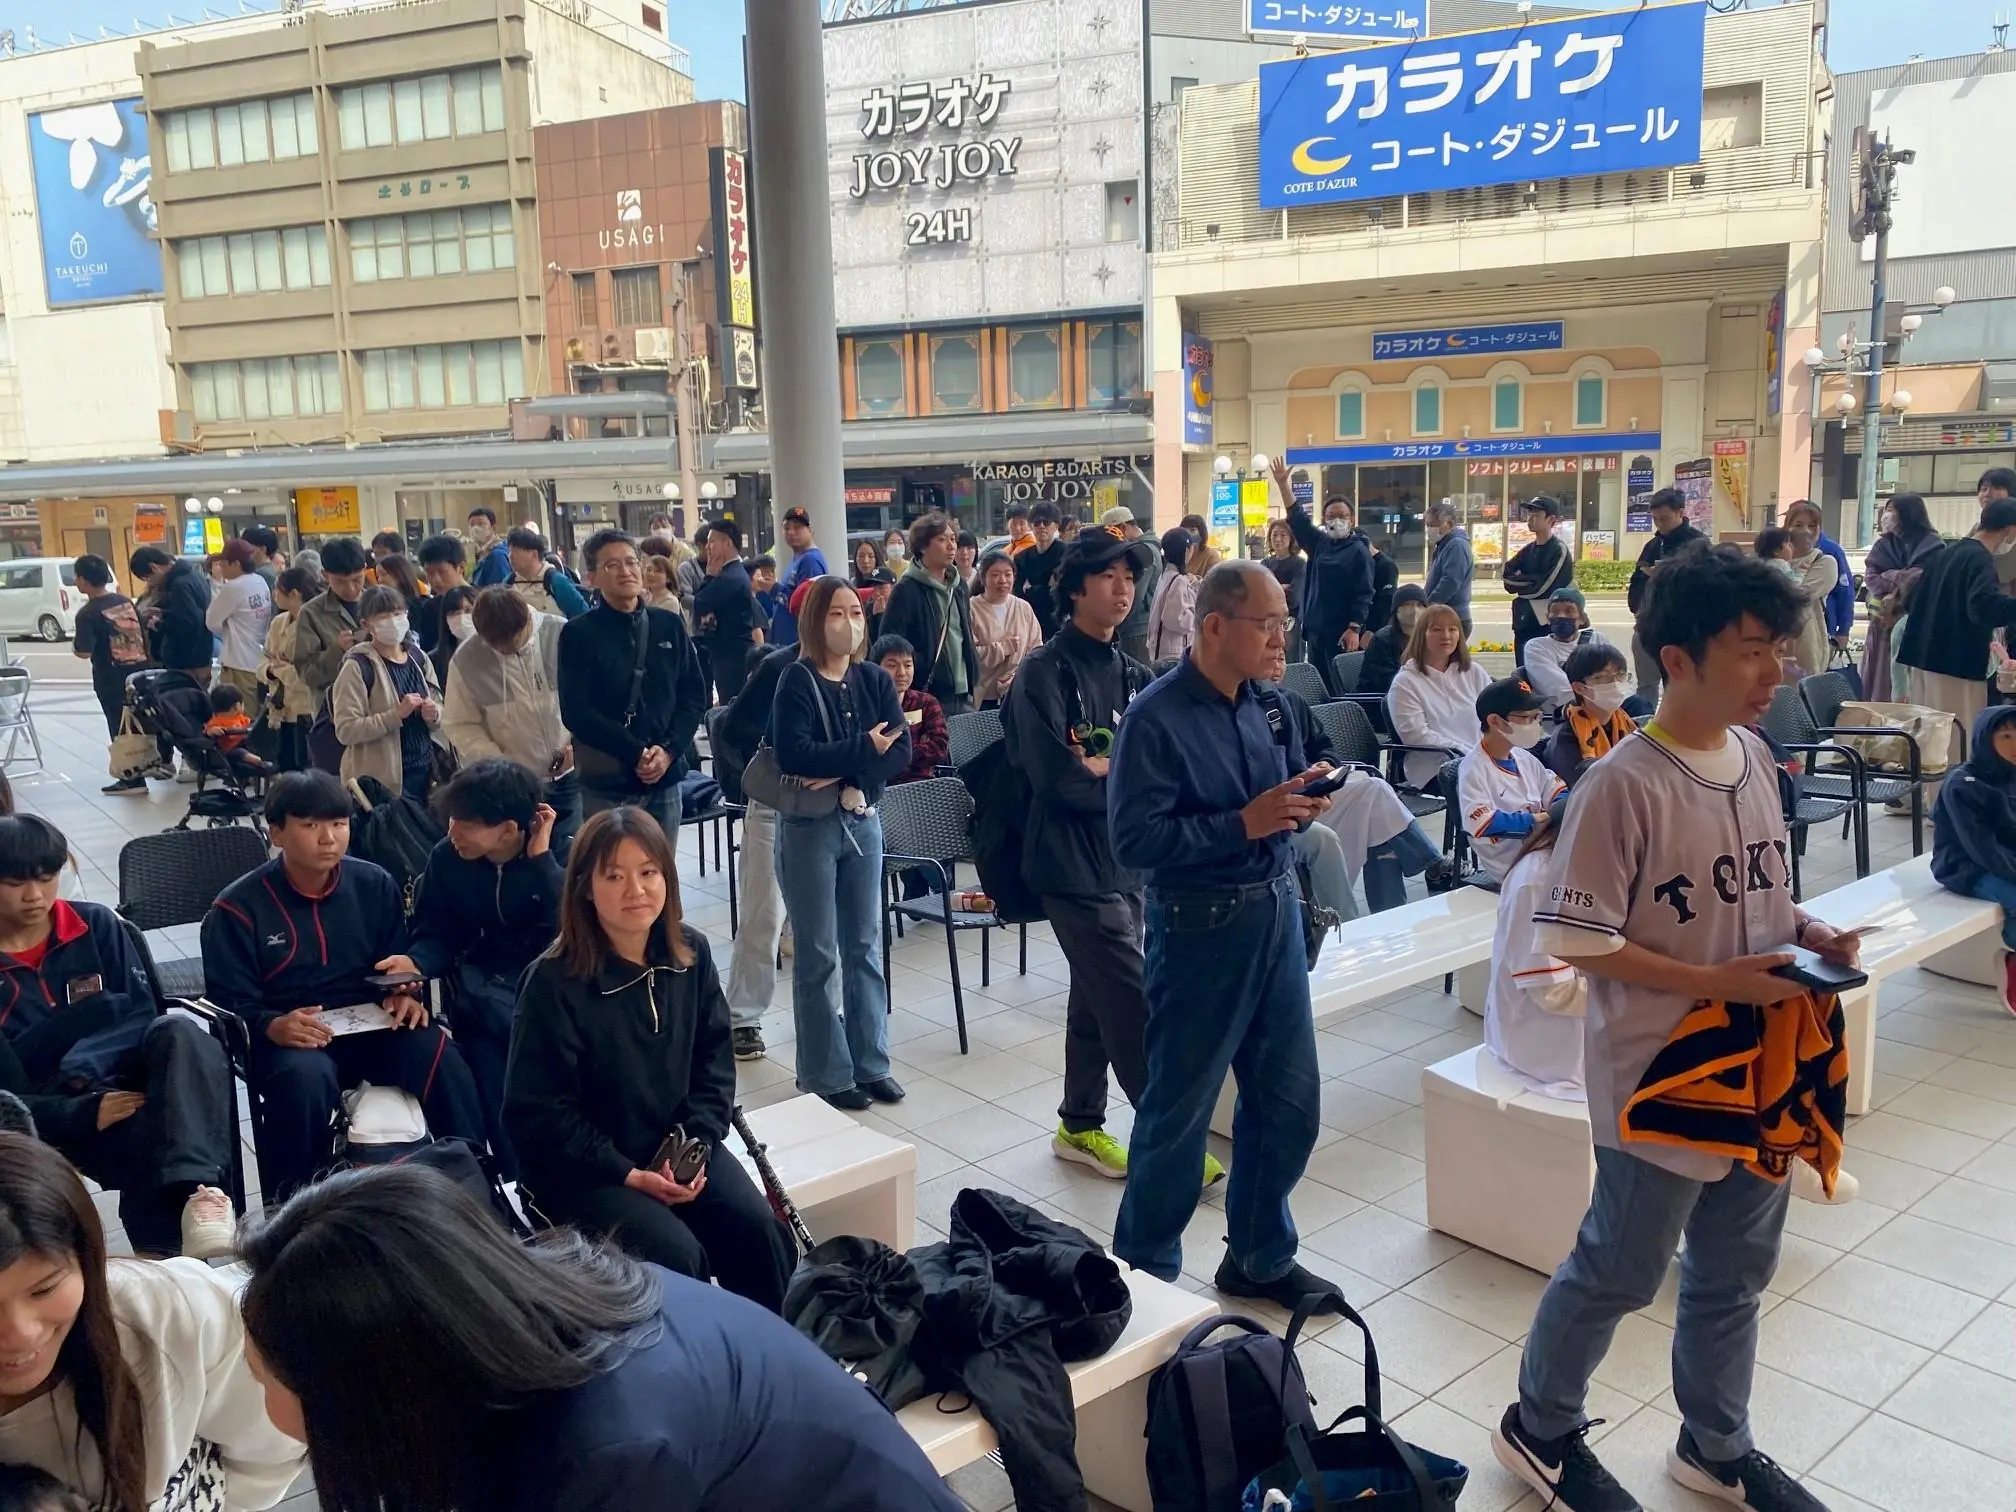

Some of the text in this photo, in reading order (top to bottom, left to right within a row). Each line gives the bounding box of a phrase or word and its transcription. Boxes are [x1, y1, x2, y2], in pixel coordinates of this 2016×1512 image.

[1265, 2, 1411, 29] コート・ダジュール
[1326, 32, 1625, 124] カラオケ
[861, 73, 1012, 140] カラオケ
[1370, 106, 1680, 171] コート・ダジュール
[850, 136, 1023, 198] JOY JOY
[1283, 181, 1315, 196] COTE
[726, 153, 748, 276] カラオケ
[907, 207, 971, 246] 24H
[599, 223, 664, 249] USAGI
[55, 262, 108, 277] TAKEUCHI
[1376, 330, 1560, 354] カラオケ コート・ダジュール
[1393, 441, 1542, 457] カラオケ コート・ダジュール
[625, 485, 662, 496] USAG
[1002, 479, 1096, 504] JOY JOY
[1585, 533, 1612, 541] ハッピー
